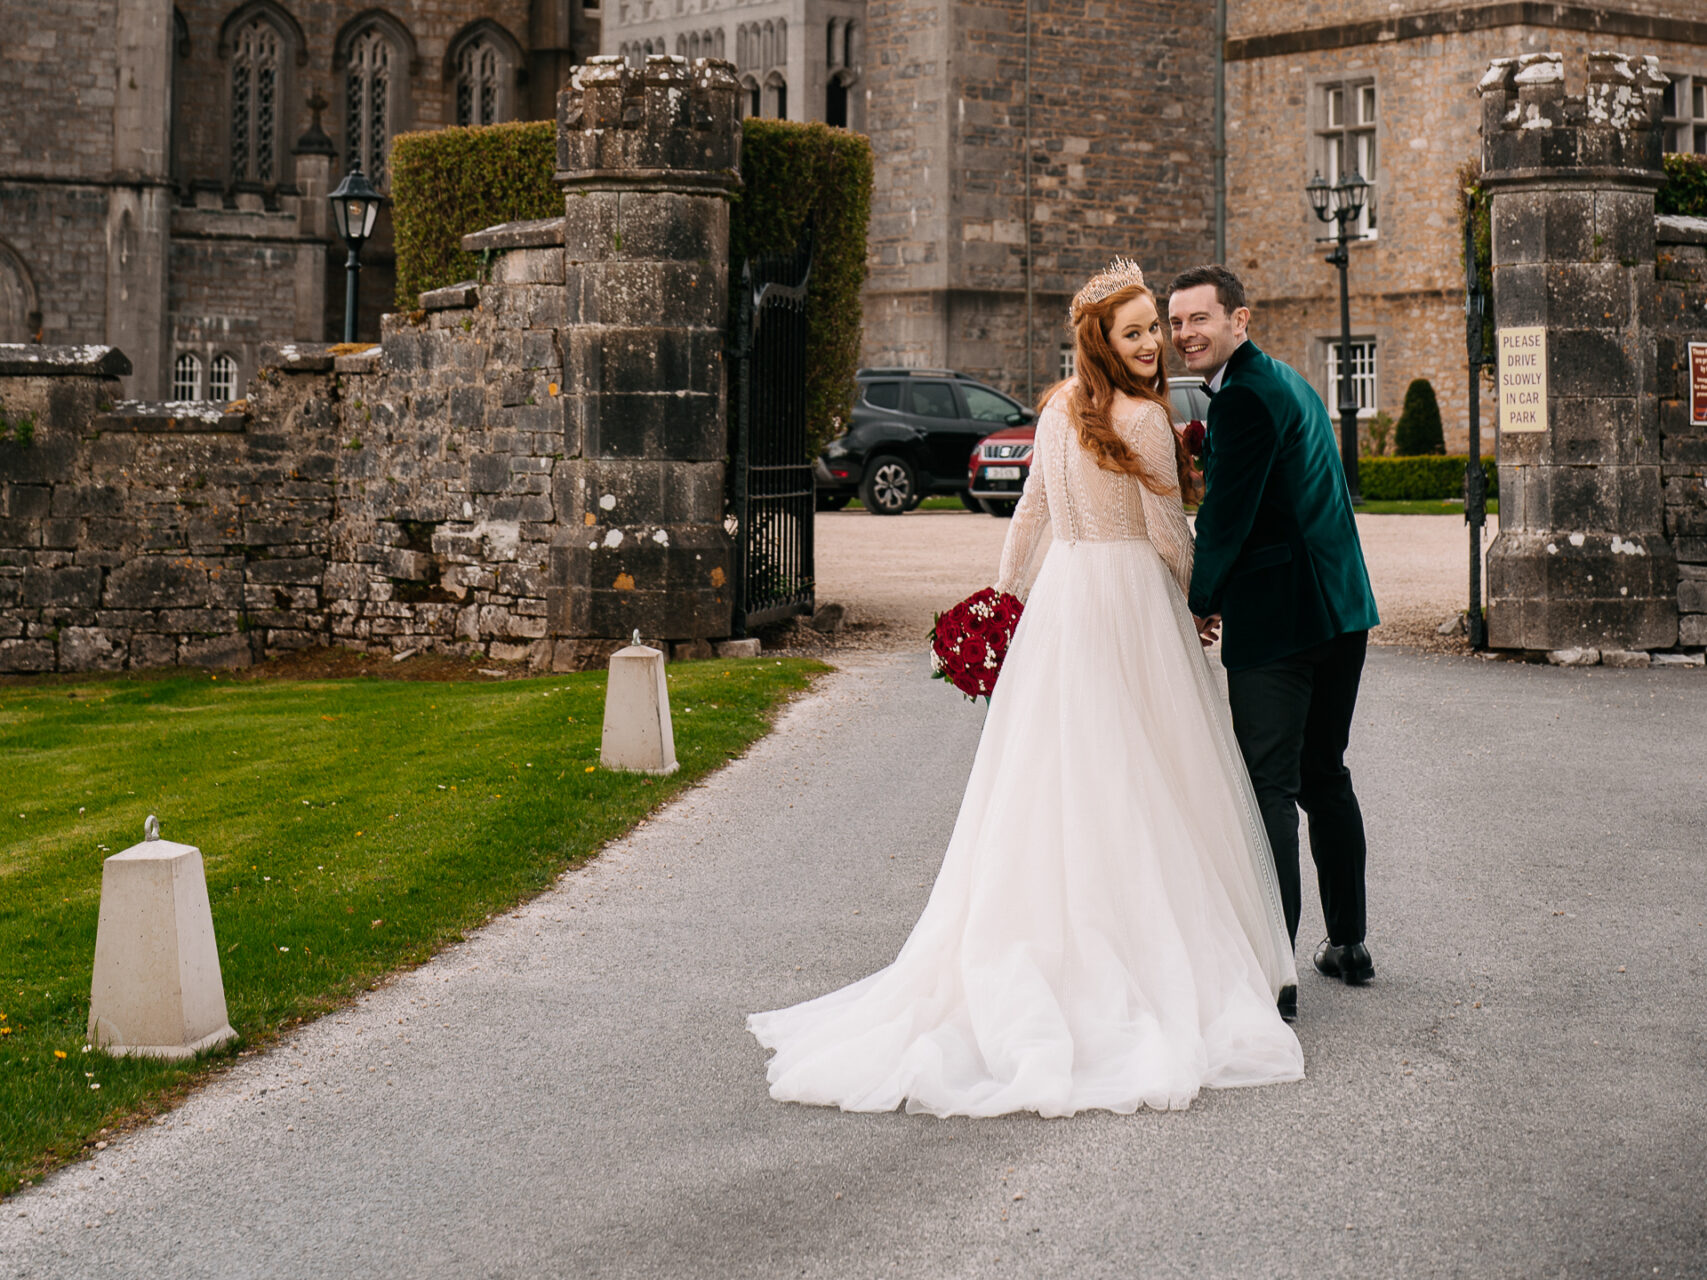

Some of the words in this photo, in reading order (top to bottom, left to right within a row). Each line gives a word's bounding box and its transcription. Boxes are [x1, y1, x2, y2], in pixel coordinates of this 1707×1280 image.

[1503, 335, 1541, 348] PLEASE
[1507, 354, 1537, 367] DRIVE
[1503, 373, 1541, 386] SLOWLY
[1506, 393, 1516, 405] IN
[1519, 392, 1539, 404] CAR
[1510, 411, 1536, 424] PARK
